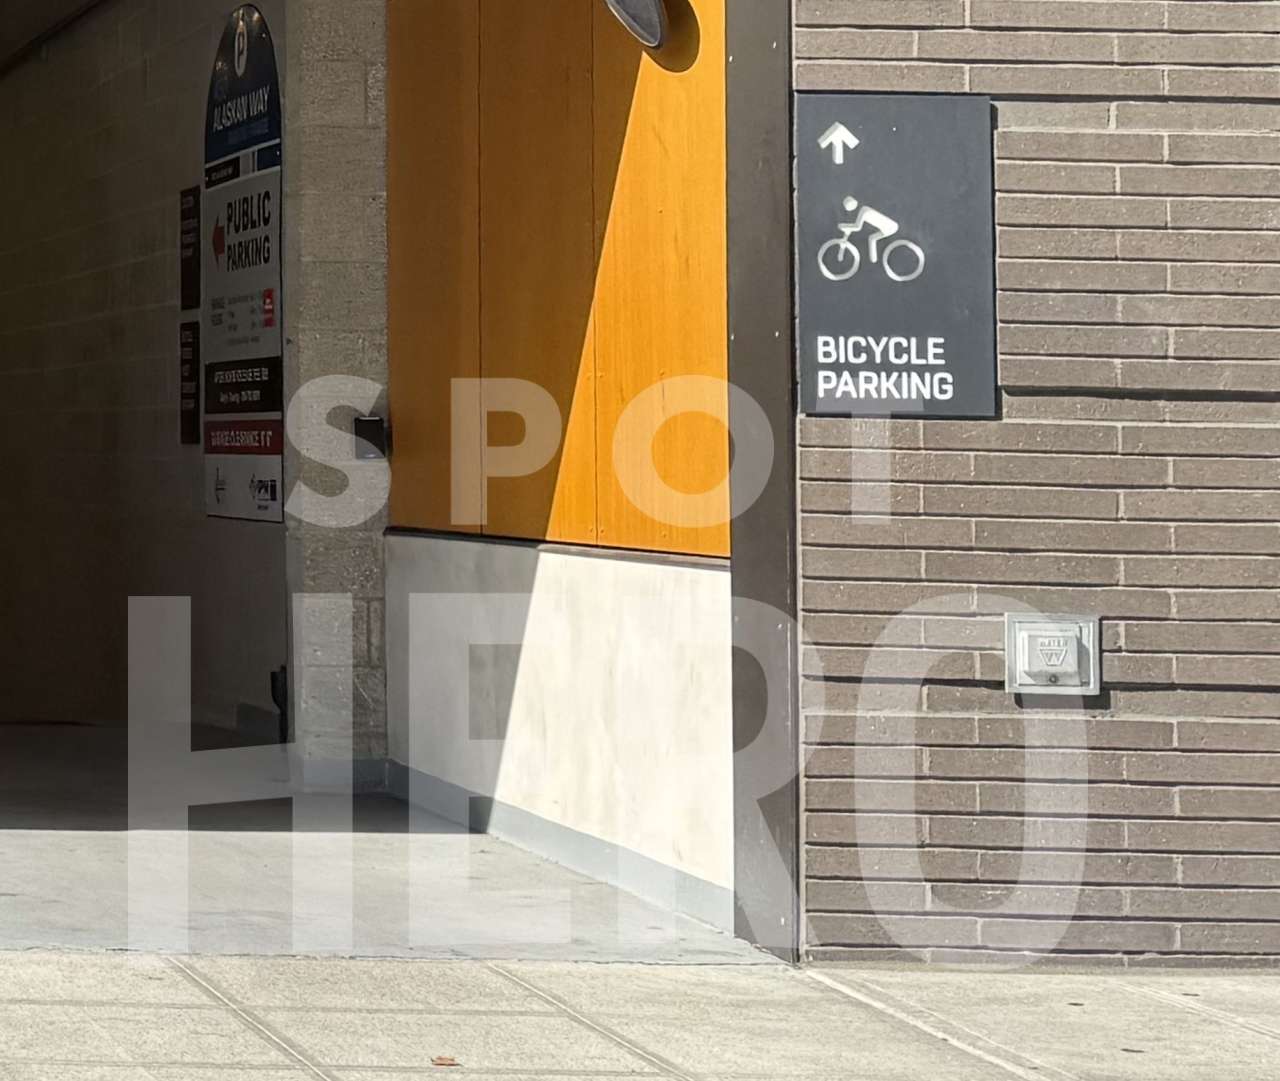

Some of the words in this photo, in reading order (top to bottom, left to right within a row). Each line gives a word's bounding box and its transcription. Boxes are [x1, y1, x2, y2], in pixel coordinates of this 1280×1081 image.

[213, 95, 248, 132] ALASKAN
[249, 84, 270, 117] WAY
[227, 191, 271, 236] PUBLIC
[227, 235, 271, 272] PARKING
[817, 335, 946, 365] BICYCLE
[817, 370, 954, 400] PARKING
